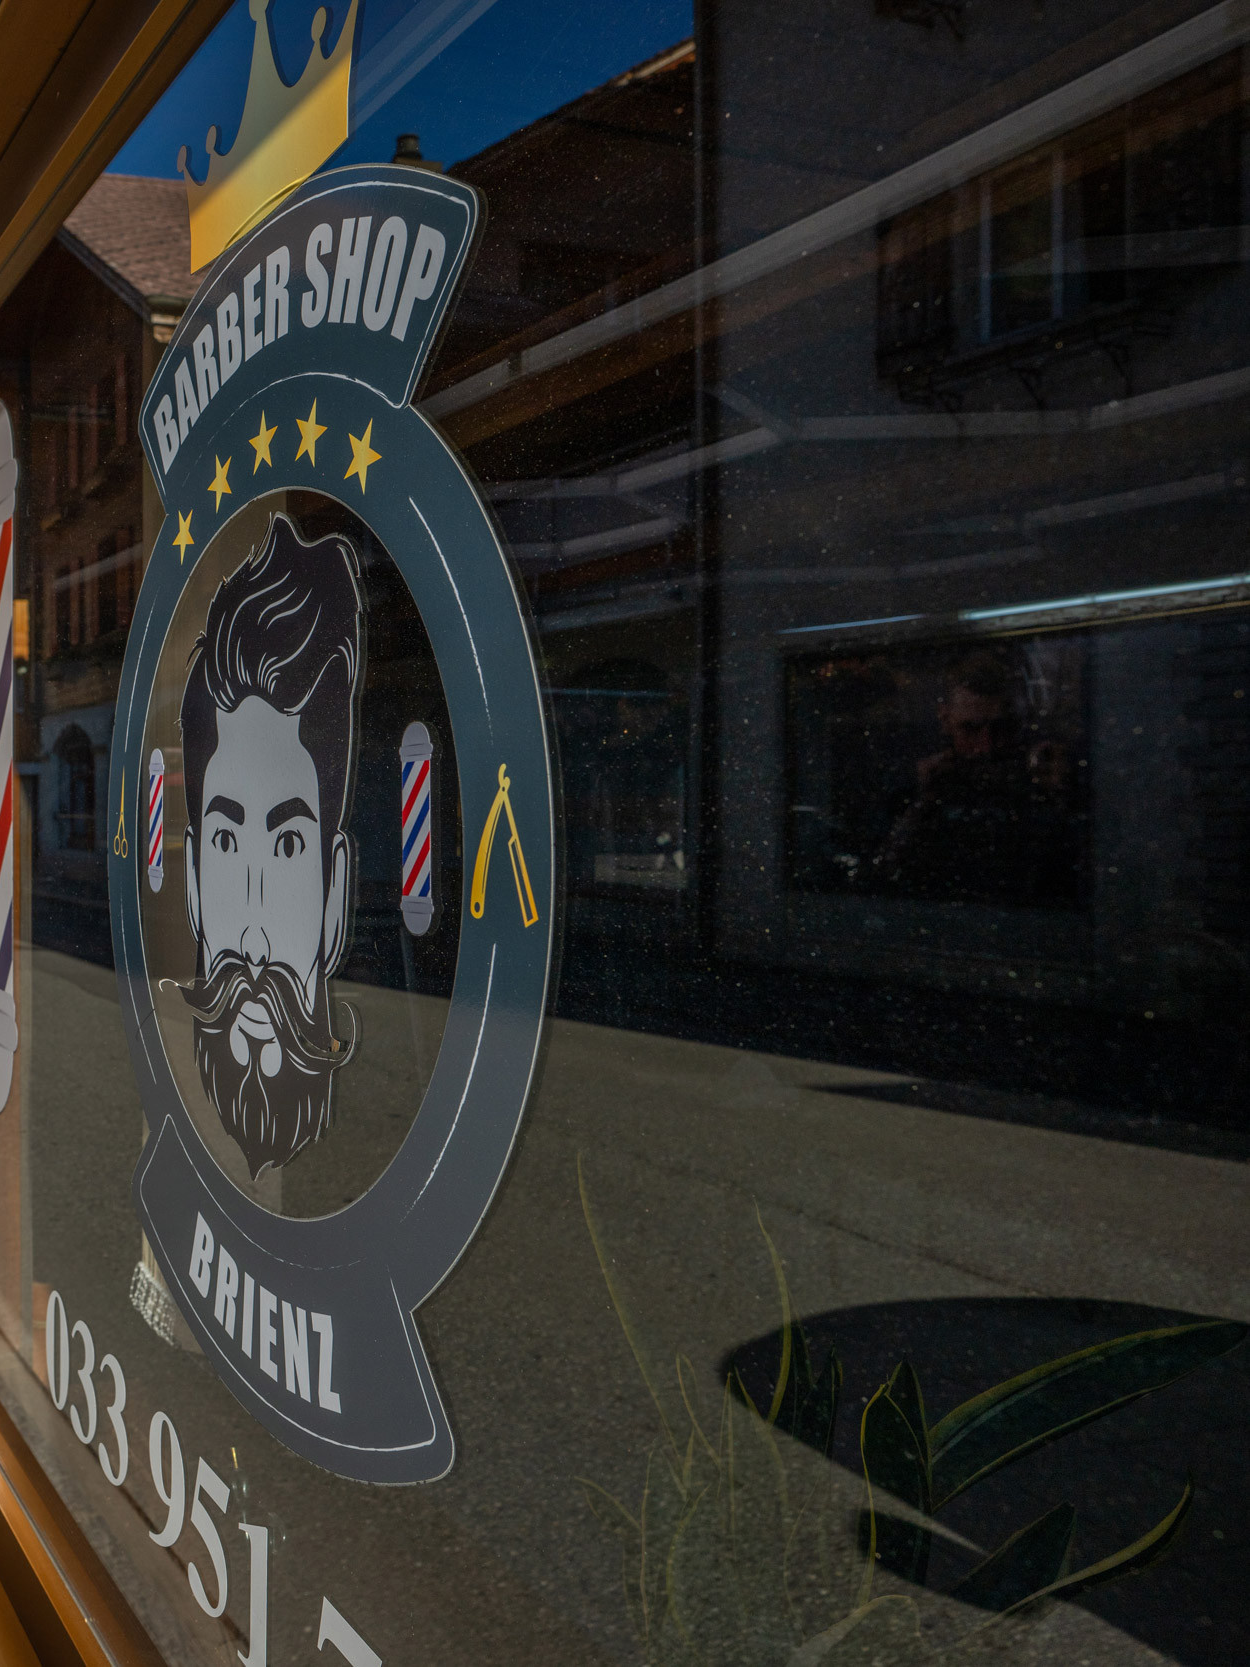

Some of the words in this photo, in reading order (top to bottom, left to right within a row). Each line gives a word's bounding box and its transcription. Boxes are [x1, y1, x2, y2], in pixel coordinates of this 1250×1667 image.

[153, 245, 291, 476] BARBER
[300, 215, 447, 343] SHOP
[188, 1210, 342, 1415] BRIENZ
[45, 1289, 129, 1487] 033
[148, 1410, 269, 1667] 951
